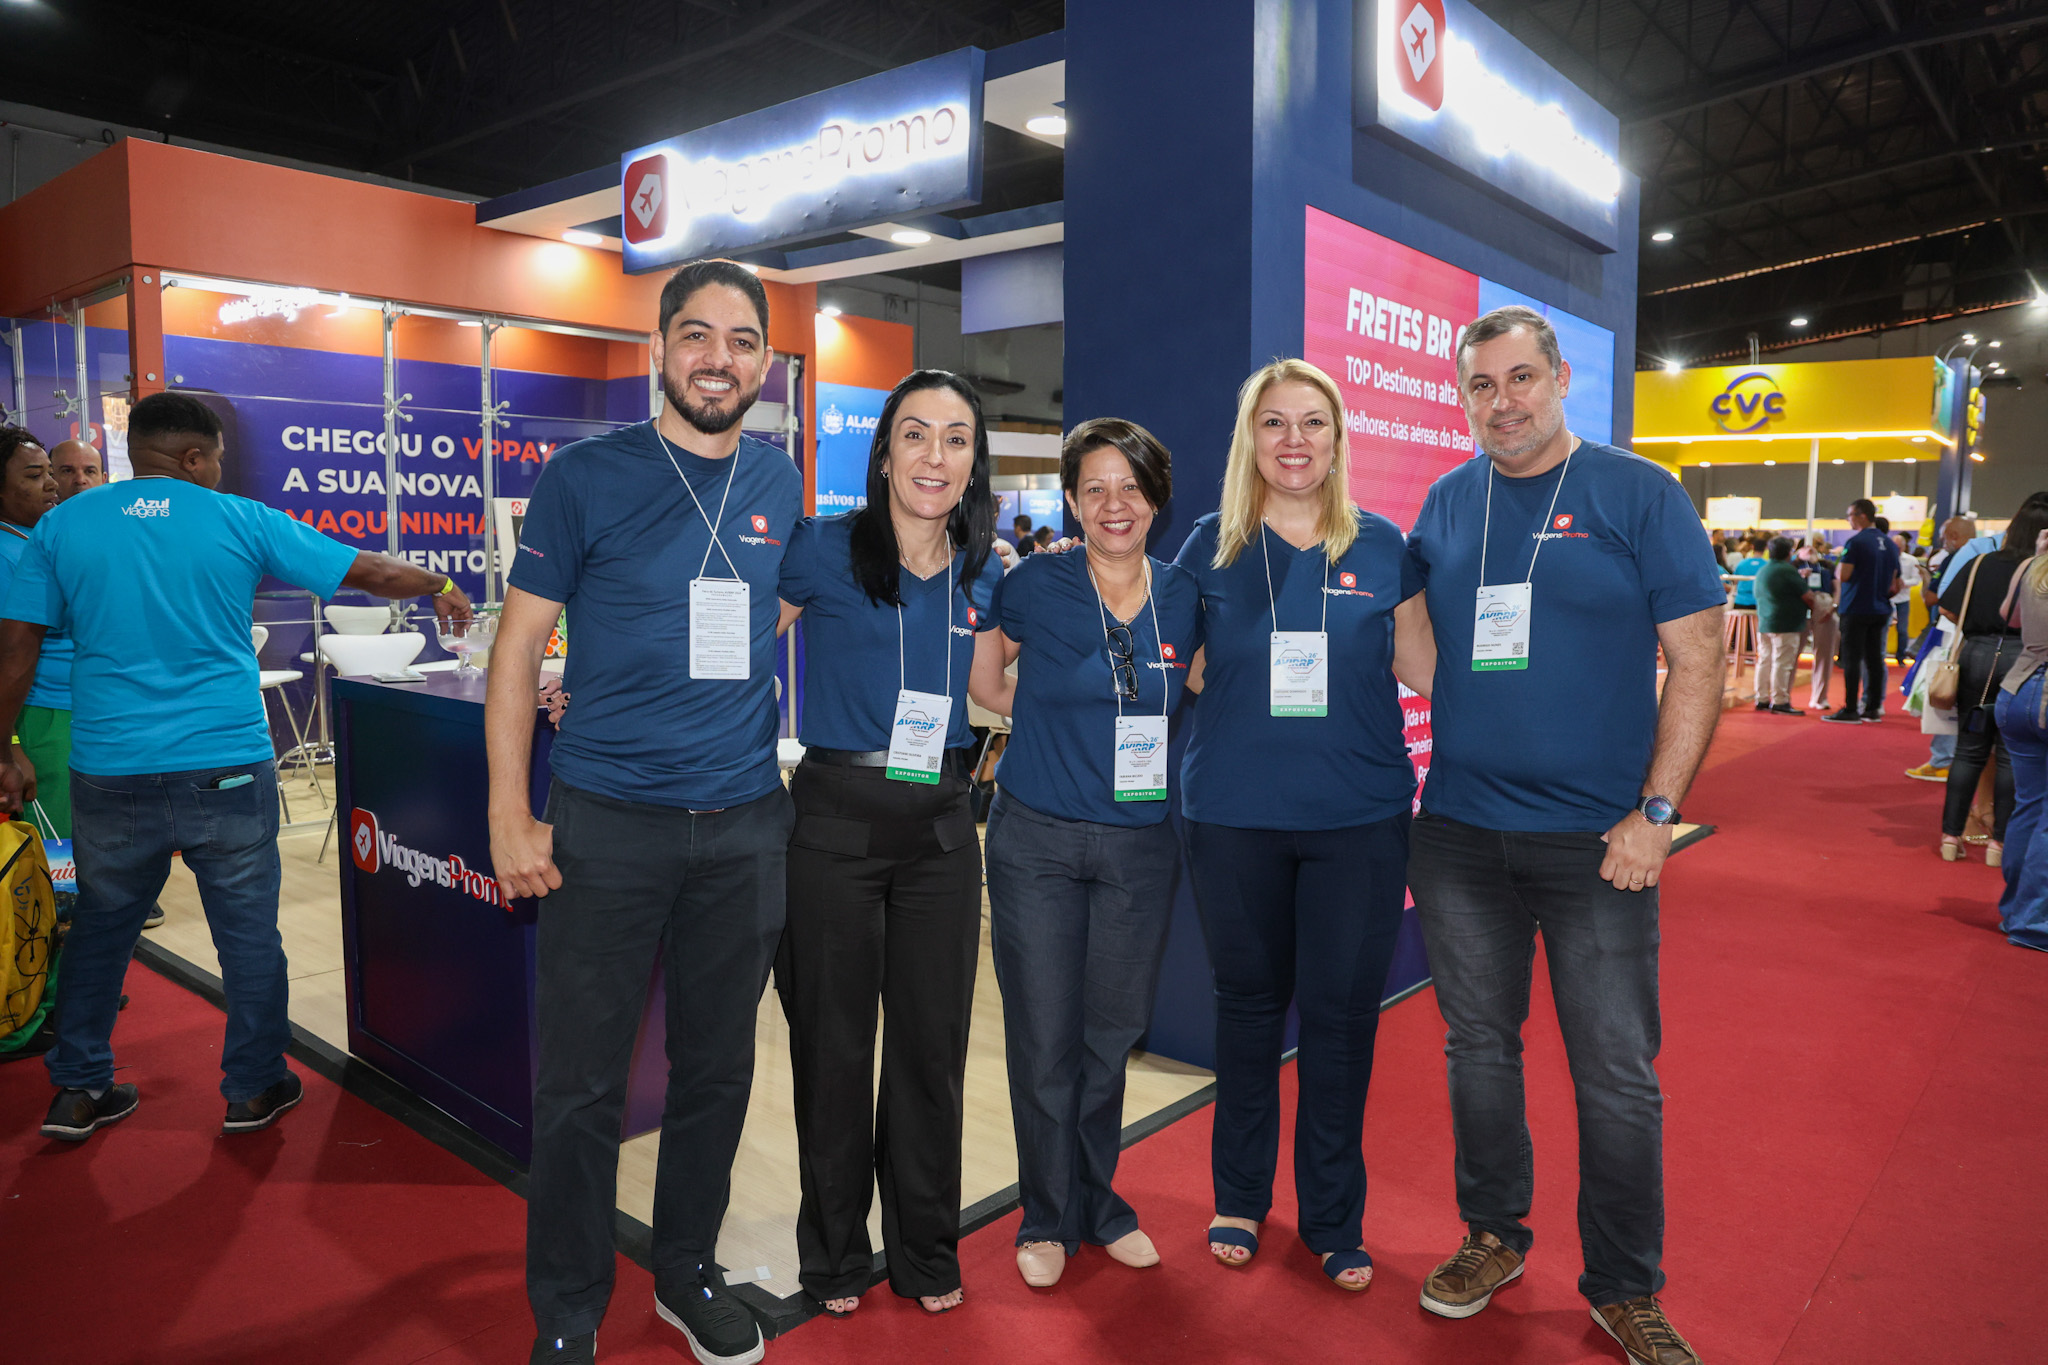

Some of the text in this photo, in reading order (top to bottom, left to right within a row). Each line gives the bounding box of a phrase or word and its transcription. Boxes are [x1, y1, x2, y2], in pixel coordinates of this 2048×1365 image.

[680, 106, 957, 216] agensPromo
[1346, 287, 1424, 352] FRETES
[1426, 315, 1452, 360] BR
[1345, 355, 1458, 406] TOP Destinos na alta
[1712, 392, 1784, 415] CVC
[845, 414, 880, 430] ALAG
[1345, 408, 1474, 452] Melhores cias aéreas do Brasil
[849, 428, 874, 436] GOVE
[281, 426, 423, 458] CHEGOU
[431, 435, 455, 459] O
[282, 467, 483, 498] A SUA NOVA
[133, 497, 170, 509] Azul
[816, 490, 855, 507] usivos
[121, 504, 170, 518] viagens
[285, 508, 498, 540] MAQUNINHA
[739, 534, 781, 546] ViagensPromo
[1532, 531, 1589, 541] ViagensPromo
[519, 543, 544, 558] gensCorp
[1321, 586, 1374, 598] ViagensPromo
[895, 770, 930, 778] EXPOSITOR
[379, 830, 514, 912] ViagensProm
